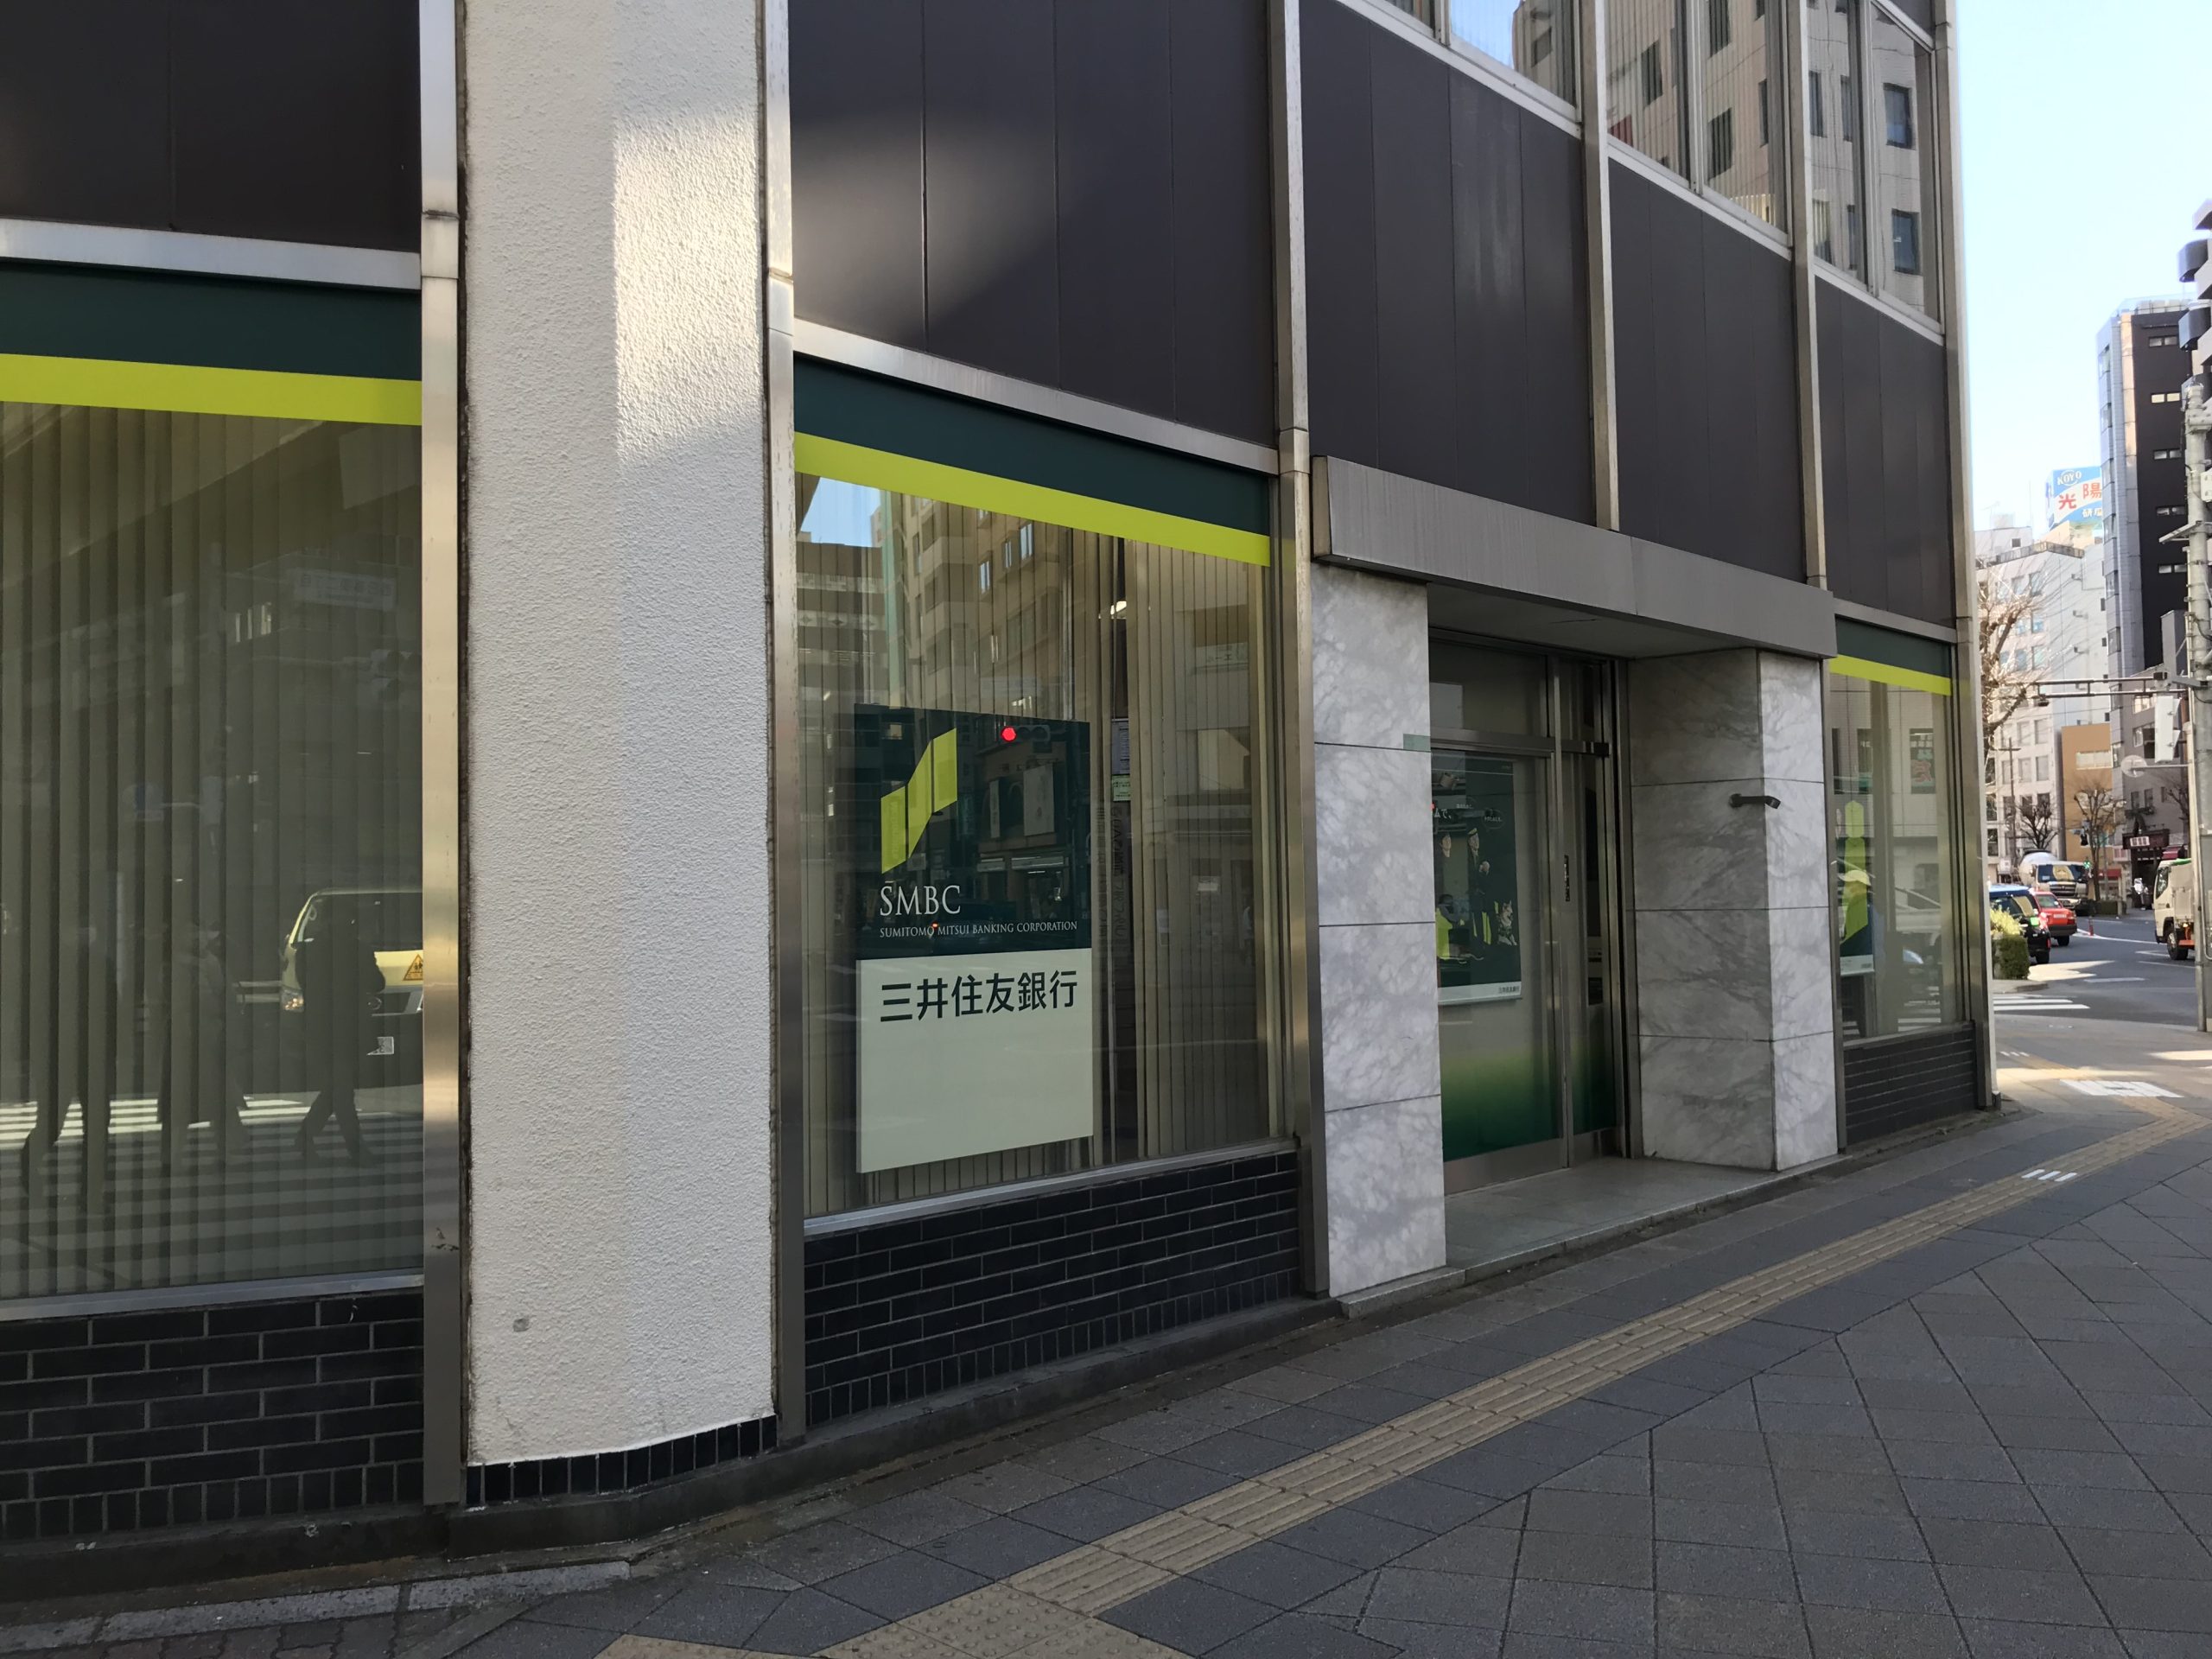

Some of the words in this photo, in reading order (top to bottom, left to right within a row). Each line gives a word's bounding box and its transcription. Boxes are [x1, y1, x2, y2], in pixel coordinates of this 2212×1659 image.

[2056, 470, 2082, 486] KOYO
[880, 885, 961, 916] SMBC
[880, 926, 935, 938] SUMITOMO
[938, 925, 969, 936] MITSUI
[972, 923, 1014, 934] BANKING
[1016, 920, 1077, 932] CORPORATION
[880, 969, 1077, 1022] 三井住友銀行
